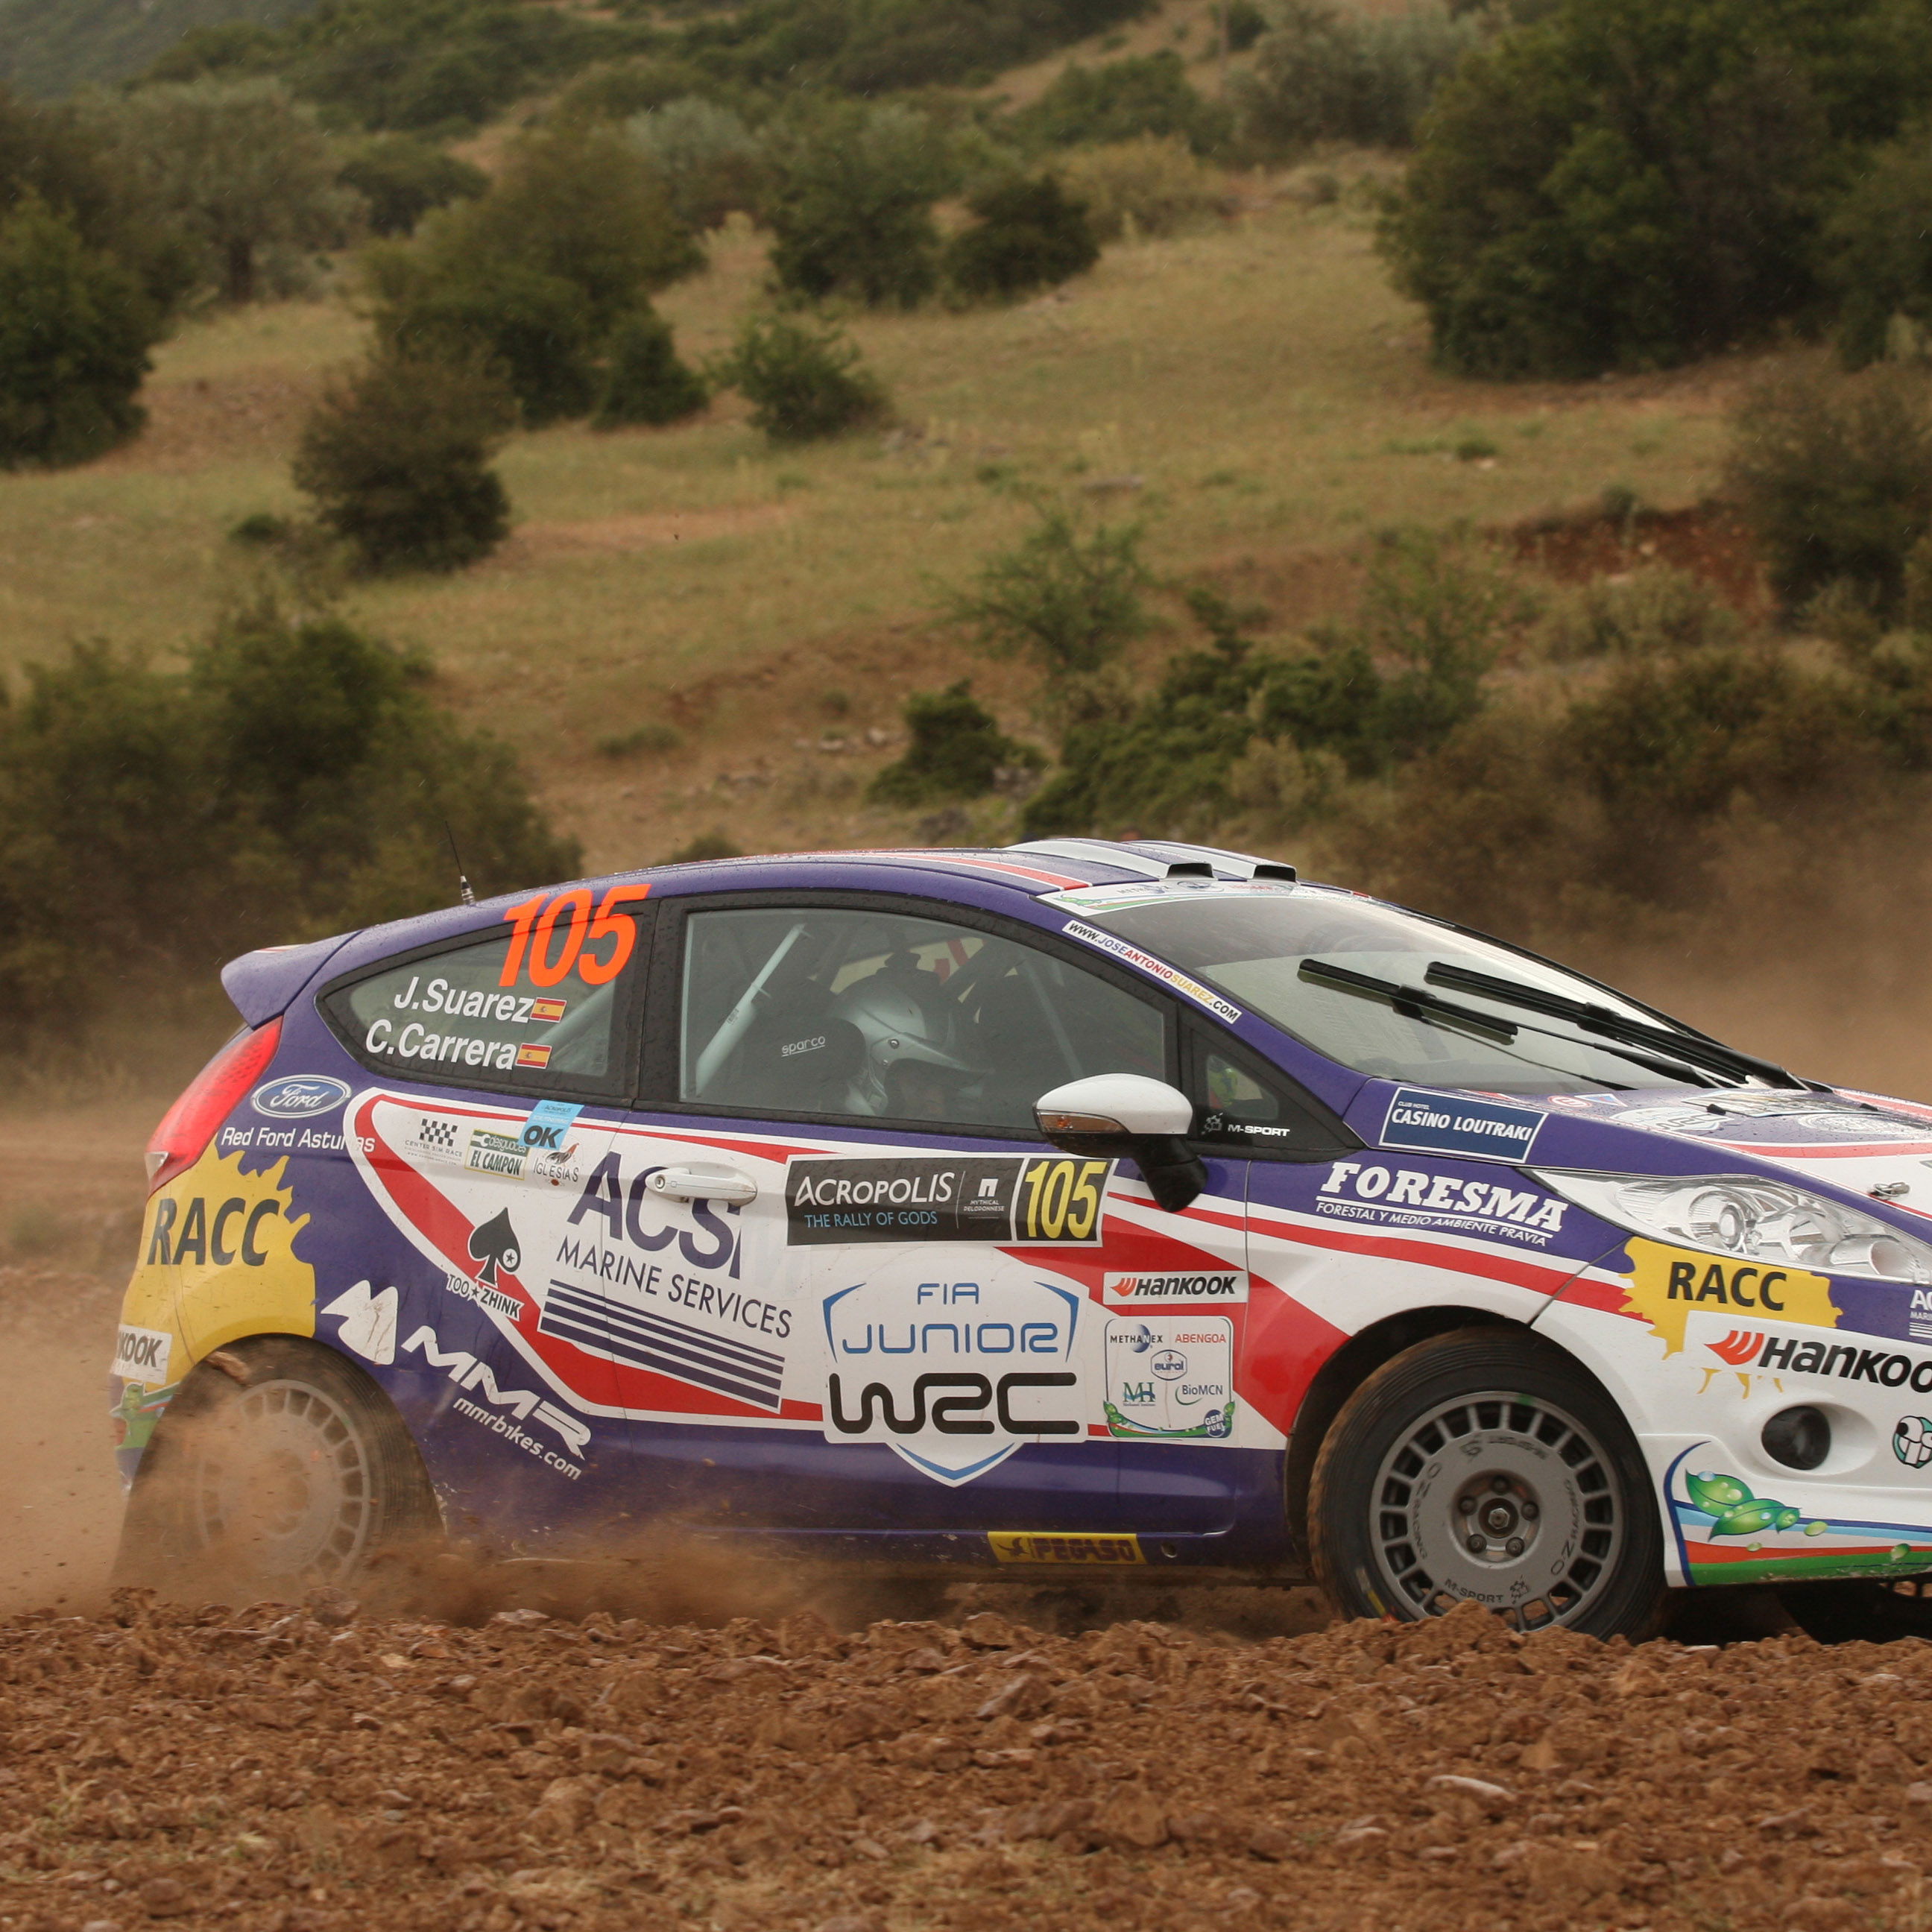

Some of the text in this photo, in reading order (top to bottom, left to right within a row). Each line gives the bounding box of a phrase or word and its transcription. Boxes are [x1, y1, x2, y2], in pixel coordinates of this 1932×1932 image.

[499, 884, 651, 987] 105
[1069, 922, 1239, 1022] WWW.JOSEANTONIOSUAREZ.COM
[394, 976, 534, 1023] J.Suarez
[366, 1019, 517, 1070] C.Carrera
[781, 1036, 826, 1056] sparco
[270, 1084, 330, 1108] Ford
[524, 1126, 564, 1149] OK
[1228, 1124, 1290, 1137] M-SPORT
[1392, 1108, 1533, 1141] CASINO LOUTRAKI
[221, 1127, 376, 1152] Red Ford Asturas
[404, 1140, 430, 1150] CENTER
[445, 1149, 463, 1158] RACE
[470, 1149, 481, 1168] EL
[482, 1152, 523, 1175] CAMPON
[533, 1157, 580, 1182] IGLESIAS
[794, 1172, 955, 1206] ACROPOLIS
[1025, 1161, 1107, 1239] 105
[1320, 1161, 1568, 1232] FORESMA
[146, 1197, 280, 1266] RACC
[804, 1211, 938, 1228] THE RALLY OF GODS
[1316, 1202, 1546, 1247] FORESTAL Y MEDIO AMBIENTE PRAVIA
[449, 1274, 521, 1319] TOO ZHINK
[556, 1234, 792, 1339] MARINE SERVICES
[918, 1282, 980, 1305] FIA
[1667, 1261, 1787, 1311] RACC
[119, 1331, 163, 1368] KOOK
[842, 1322, 1058, 1354] JUNIOR
[1110, 1335, 1164, 1343] METHANEX
[1175, 1333, 1226, 1343] ABENGOA
[1154, 1360, 1184, 1371] eurol
[401, 1325, 591, 1460] MMR
[828, 1372, 1080, 1435] WRC
[1182, 1385, 1223, 1395] BioMCN
[1205, 1414, 1224, 1425] GEM
[1207, 1423, 1225, 1433] FUEL
[453, 1397, 581, 1480] mmrbikes.com
[1032, 1538, 1137, 1562] PEGASO
[1445, 1578, 1503, 1603] M-SPORT
